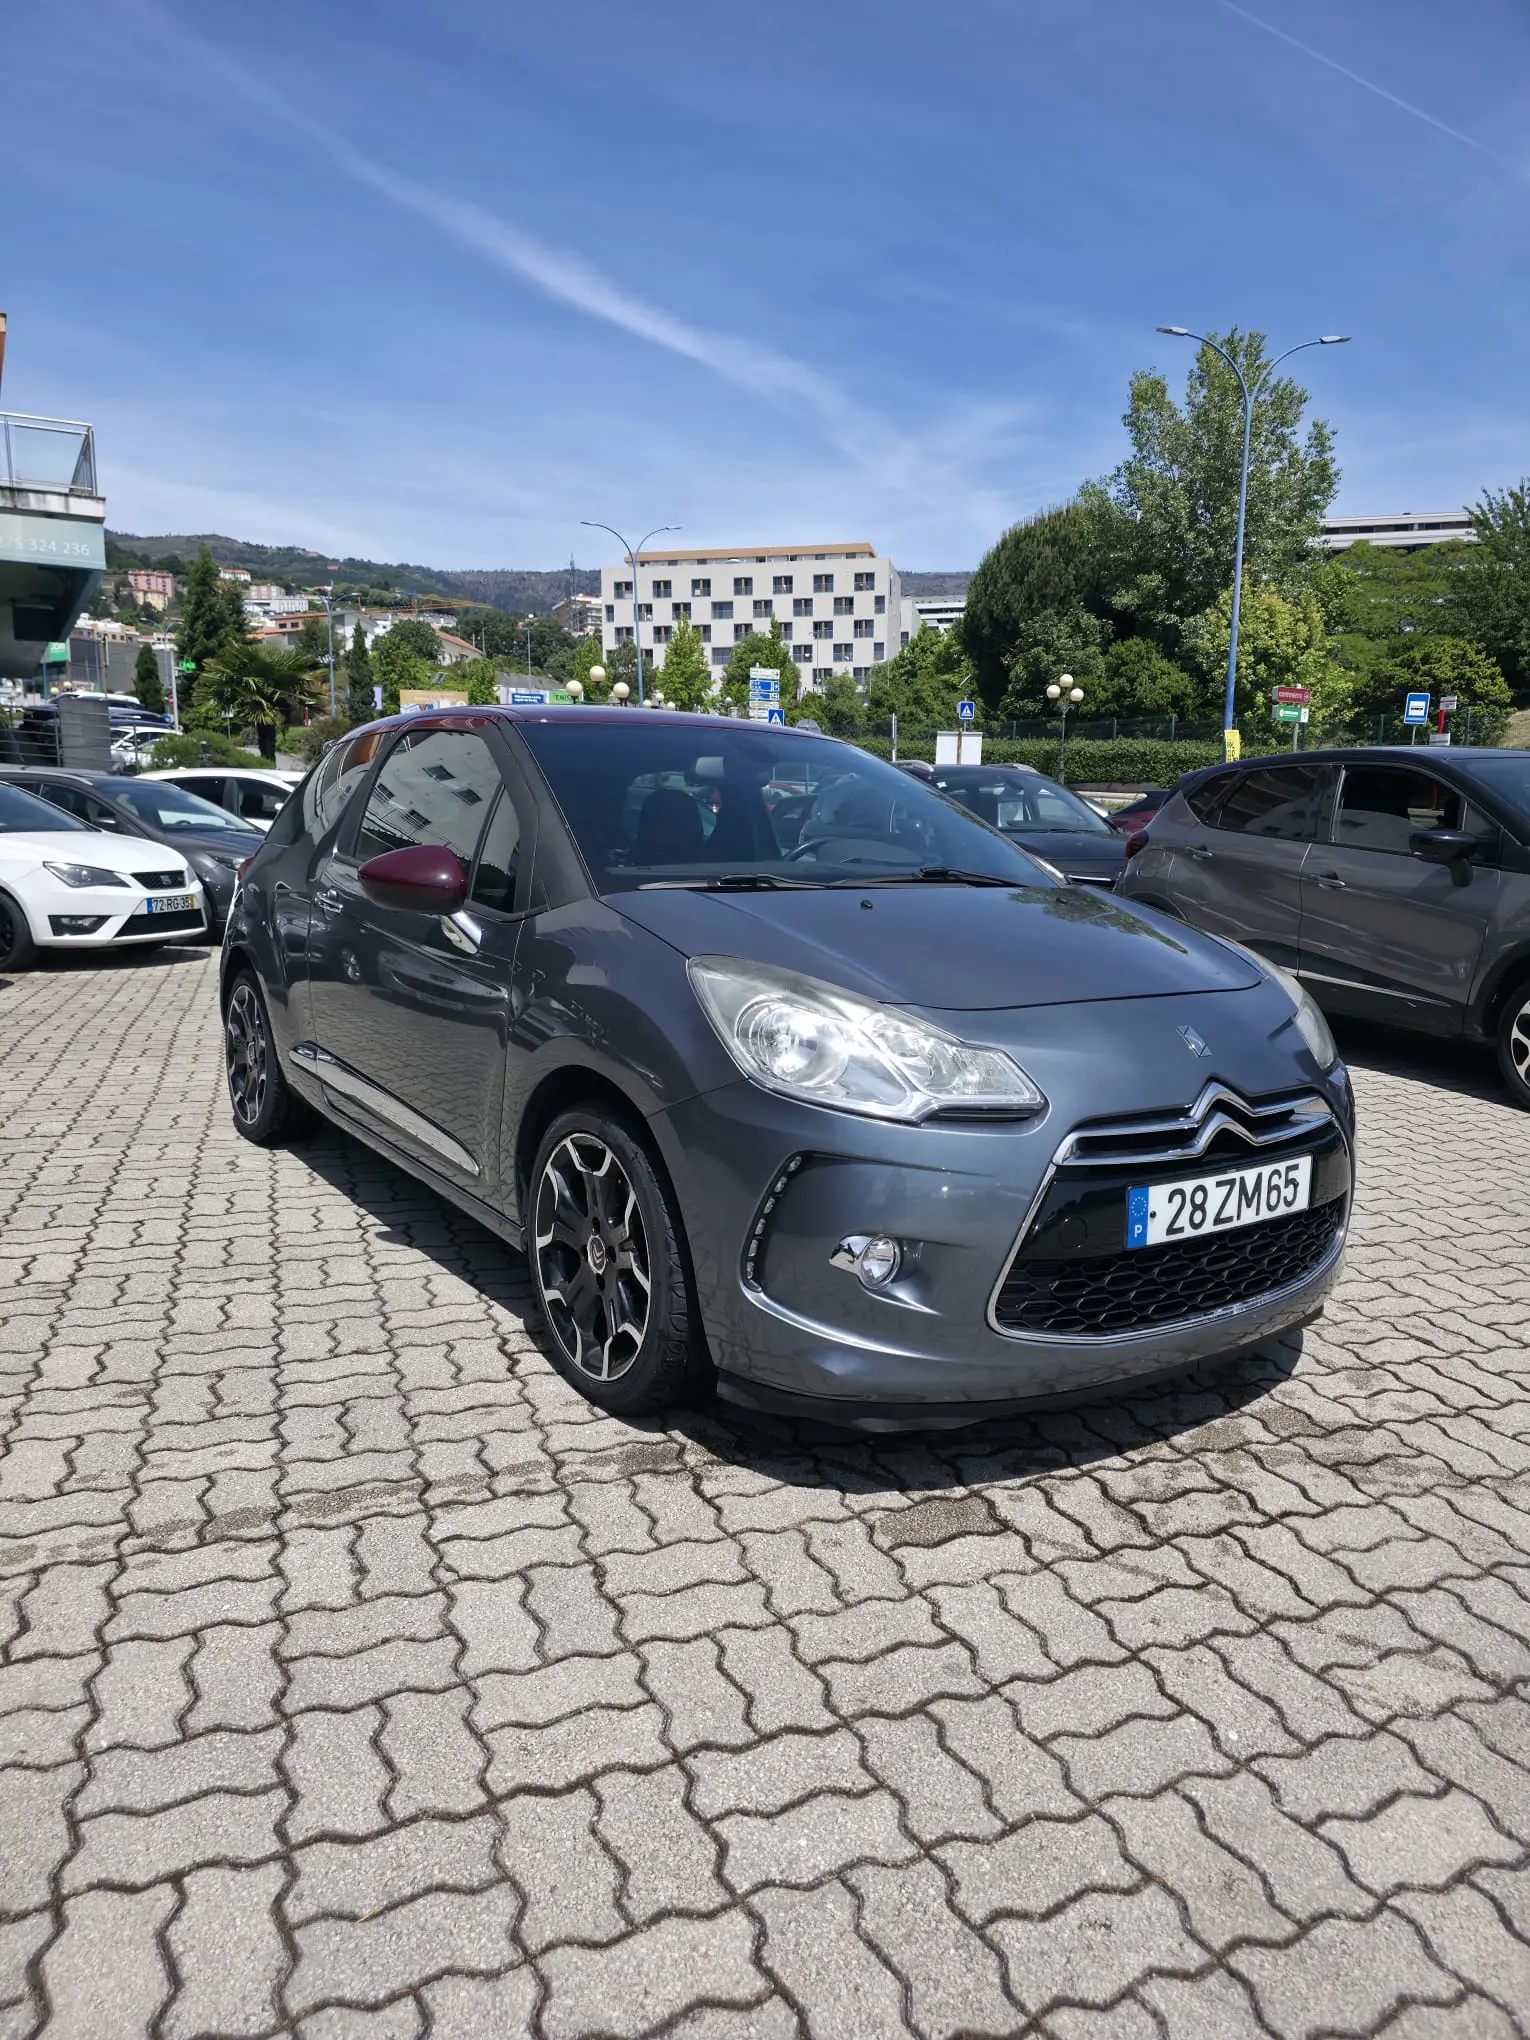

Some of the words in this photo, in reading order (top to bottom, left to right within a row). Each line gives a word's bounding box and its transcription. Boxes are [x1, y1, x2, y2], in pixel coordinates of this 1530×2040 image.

[28, 538, 57, 553] 324
[62, 541, 91, 556] 236
[1134, 1224, 1143, 1238] P
